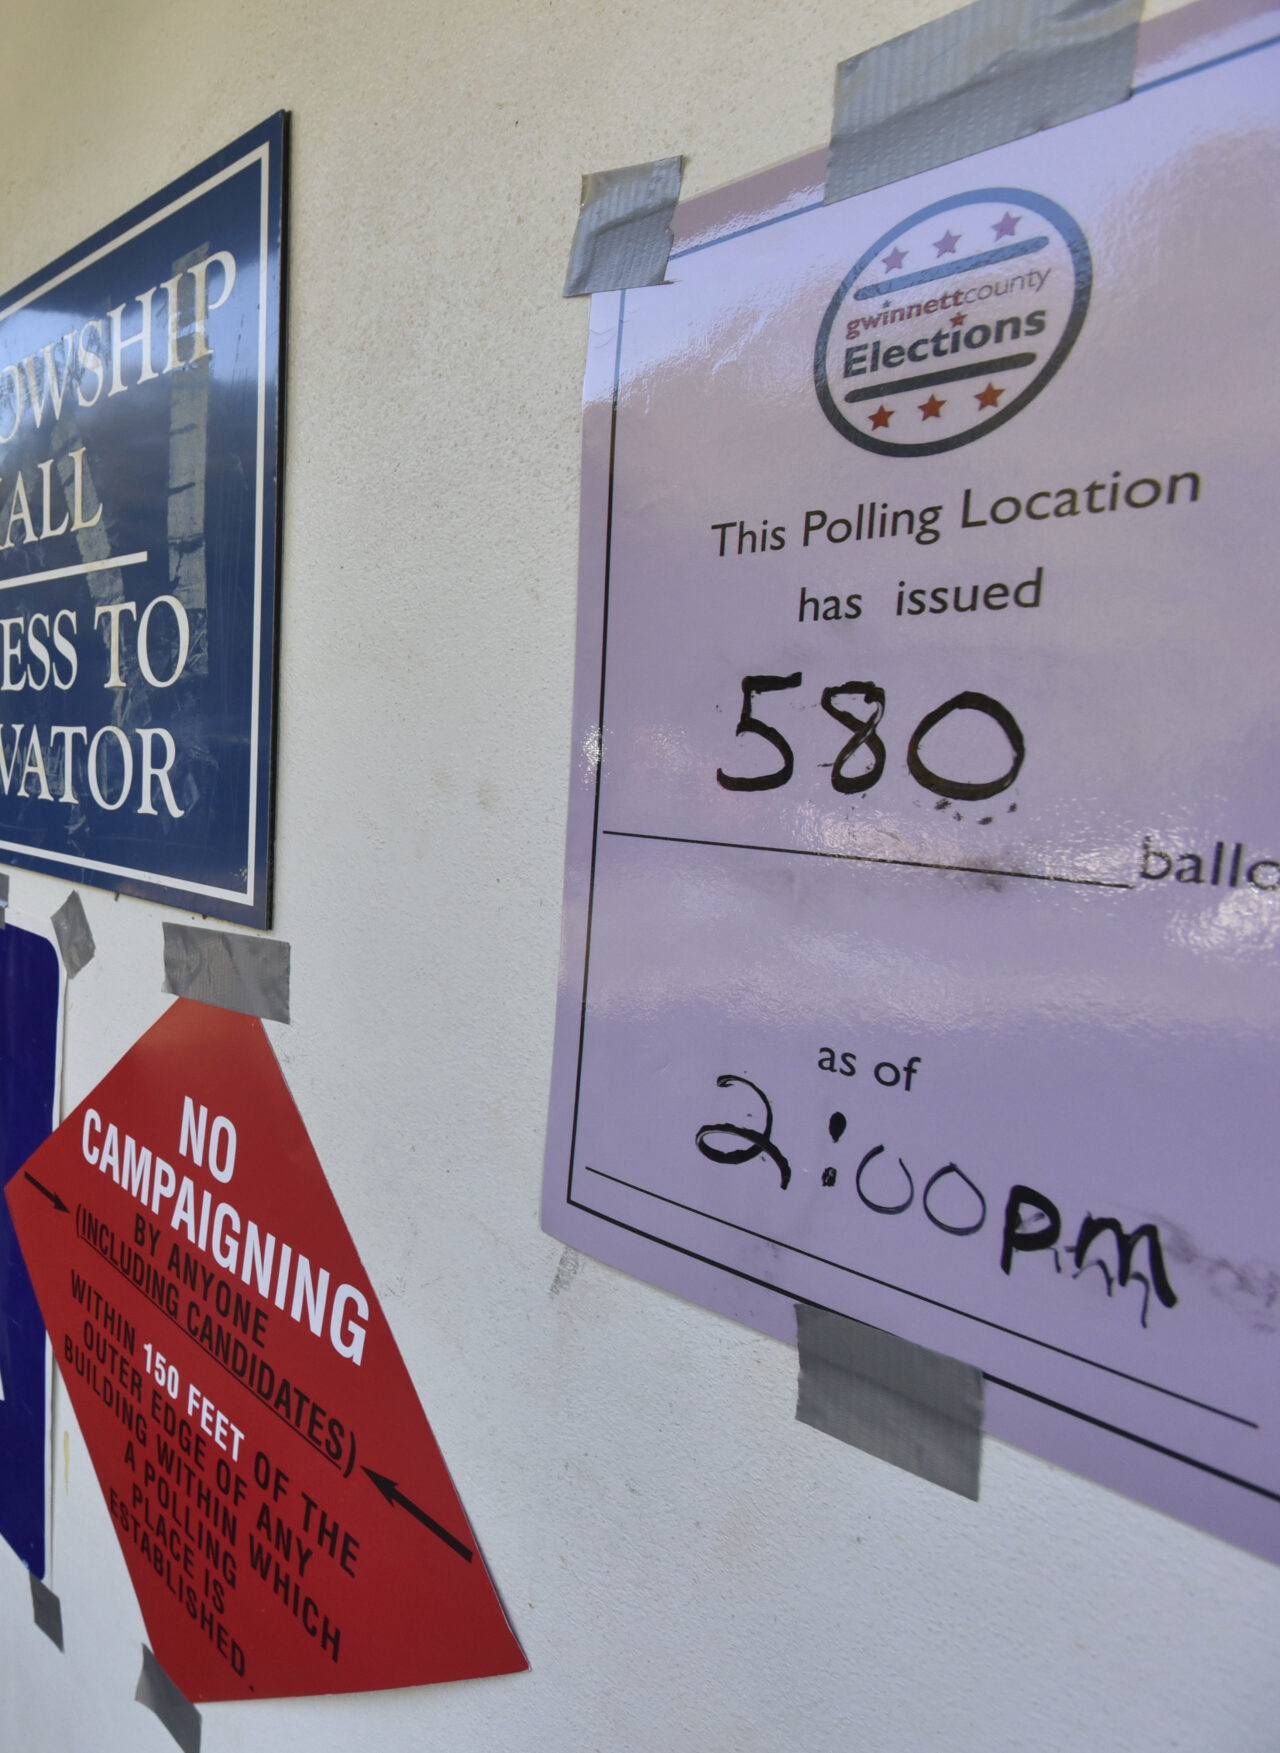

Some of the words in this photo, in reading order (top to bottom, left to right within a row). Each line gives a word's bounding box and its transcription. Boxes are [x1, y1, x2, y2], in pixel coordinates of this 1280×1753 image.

[844, 308, 1047, 379] Elections
[711, 519, 786, 557] This
[802, 501, 943, 546] Polling
[960, 470, 1202, 529] Location
[94, 595, 190, 688] TO
[798, 587, 863, 622] has
[895, 566, 1045, 616] issued
[717, 671, 1025, 801] 580
[818, 1046, 856, 1077] as
[873, 1056, 922, 1092] of
[178, 1096, 237, 1184] NO
[82, 1108, 369, 1366] CAMPAIGNING
[134, 1213, 161, 1256] BY
[167, 1243, 268, 1349] ANYONE
[76, 1203, 180, 1319] (INCLUDING
[187, 1301, 356, 1479] CANDIDATES)
[71, 1268, 135, 1356] WITHIN
[143, 1343, 179, 1400] 150
[187, 1383, 245, 1462] FEET
[254, 1451, 289, 1502] OF
[301, 1491, 360, 1579] THE
[83, 1320, 143, 1403] OUTER
[151, 1389, 206, 1471] EDGE
[216, 1458, 247, 1507] OF
[256, 1502, 312, 1578] ANY
[65, 1333, 148, 1448] BUILDING
[156, 1433, 237, 1547] WITHIN
[249, 1533, 341, 1663] WHICH
[125, 1440, 135, 1472] A
[144, 1460, 236, 1590] POLLING
[133, 1482, 194, 1579] PLACE
[205, 1568, 224, 1615] IS
